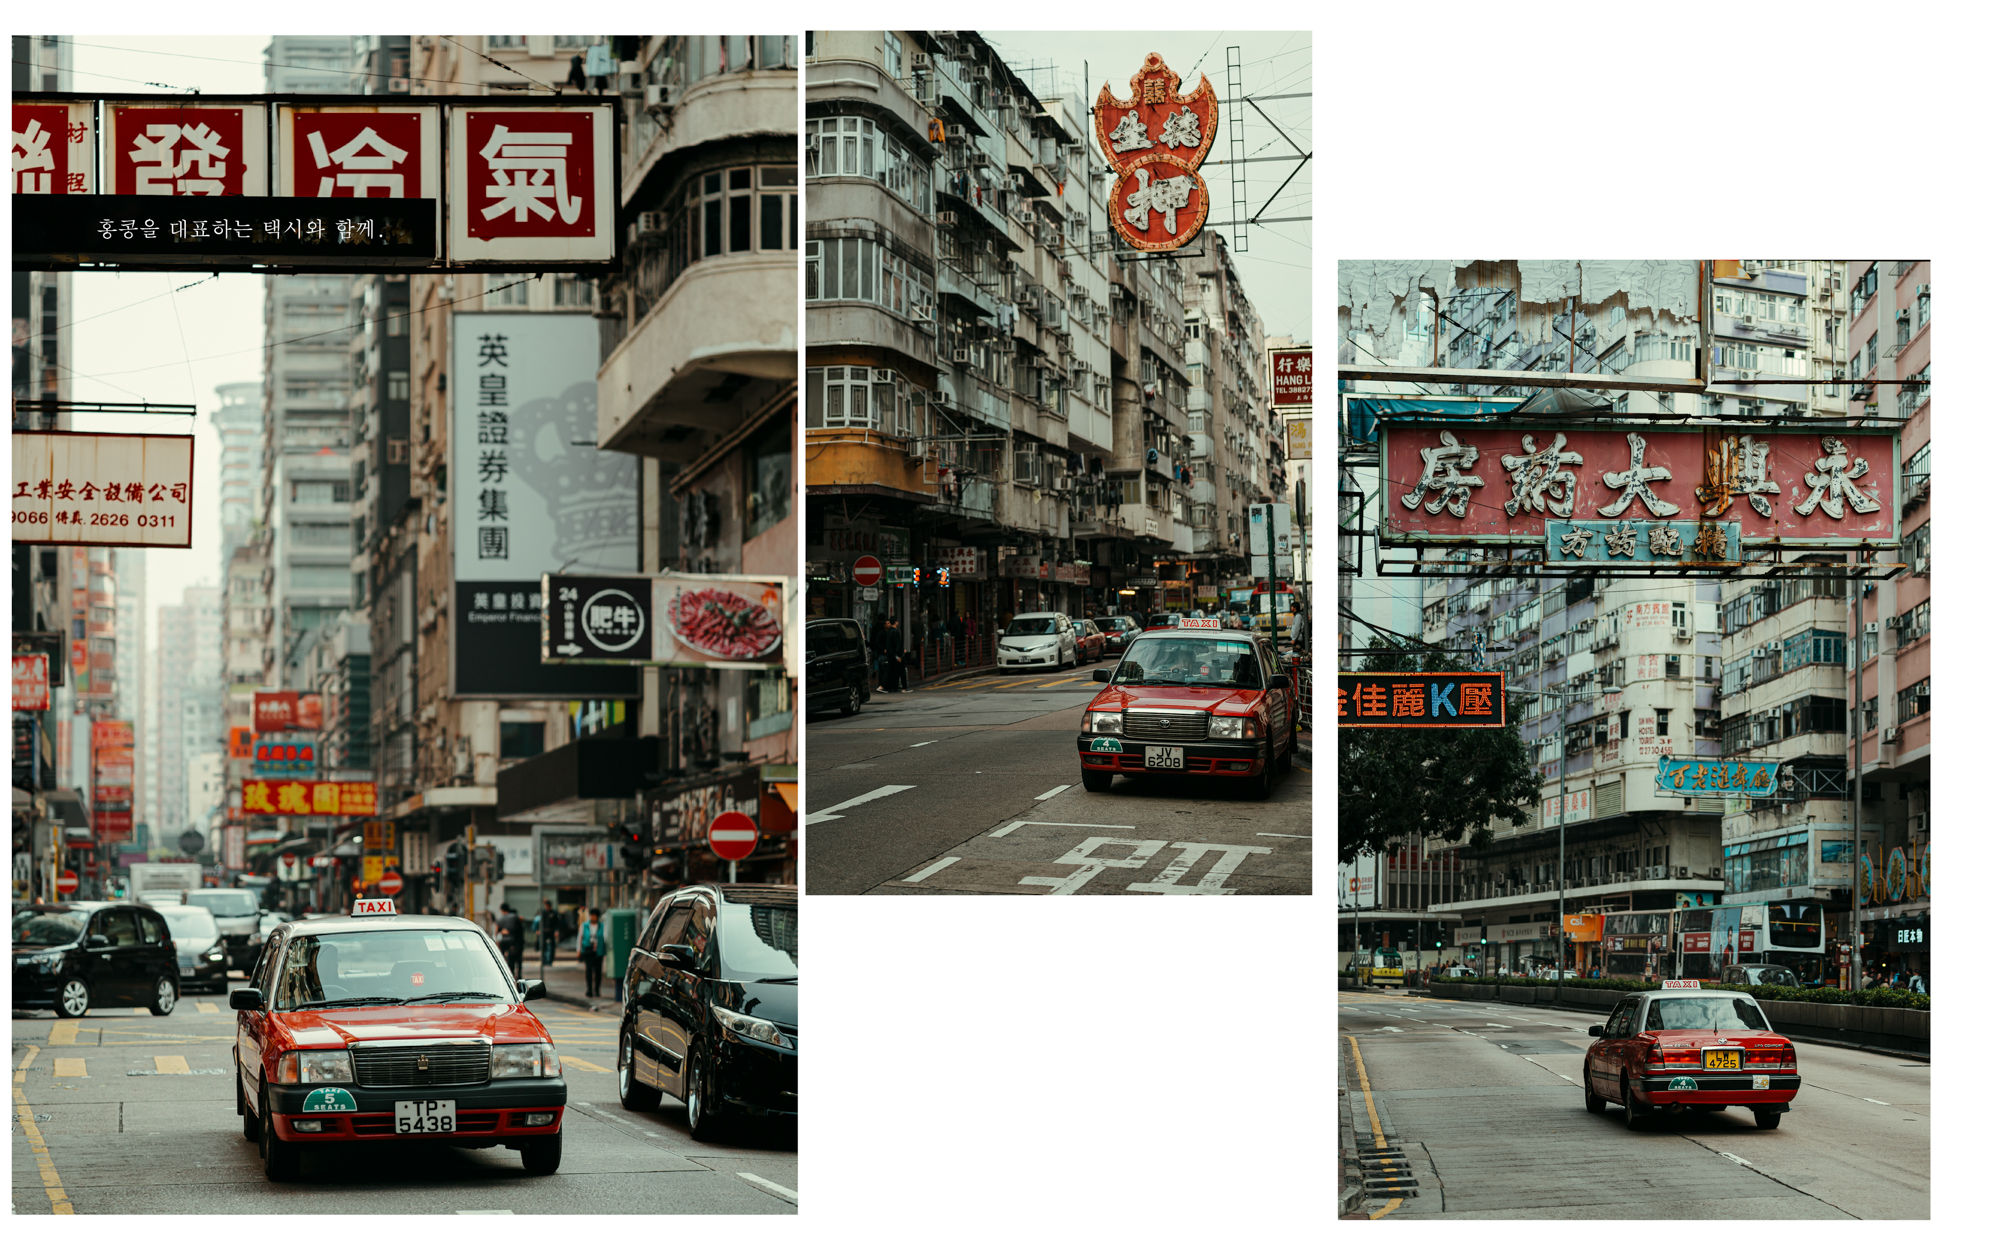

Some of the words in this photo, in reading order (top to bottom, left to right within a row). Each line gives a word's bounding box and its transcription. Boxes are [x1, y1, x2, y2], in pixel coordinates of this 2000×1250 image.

[1124, 168, 1194, 235] 押
[1276, 375, 1303, 385] HANG
[1305, 375, 1312, 385] L
[477, 333, 509, 560] 英皇證券集團
[12, 479, 187, 504] 工業安全設備公司
[91, 513, 129, 527] 2626
[137, 515, 175, 528] 0311
[559, 587, 578, 601] 24
[468, 611, 507, 624] Emperor
[590, 605, 636, 629] 肥牛
[1182, 619, 1218, 628] TAXI
[1156, 747, 1172, 758] JV
[1148, 756, 1181, 768] 6208
[358, 902, 392, 913] TAXI
[411, 976, 425, 984] TAXI
[1665, 981, 1698, 989] TAXI
[1715, 1051, 1729, 1060] LW
[1709, 1059, 1737, 1069] 4725
[325, 1093, 335, 1104] 5
[413, 1101, 438, 1116] TP
[399, 1116, 453, 1133] 5438
